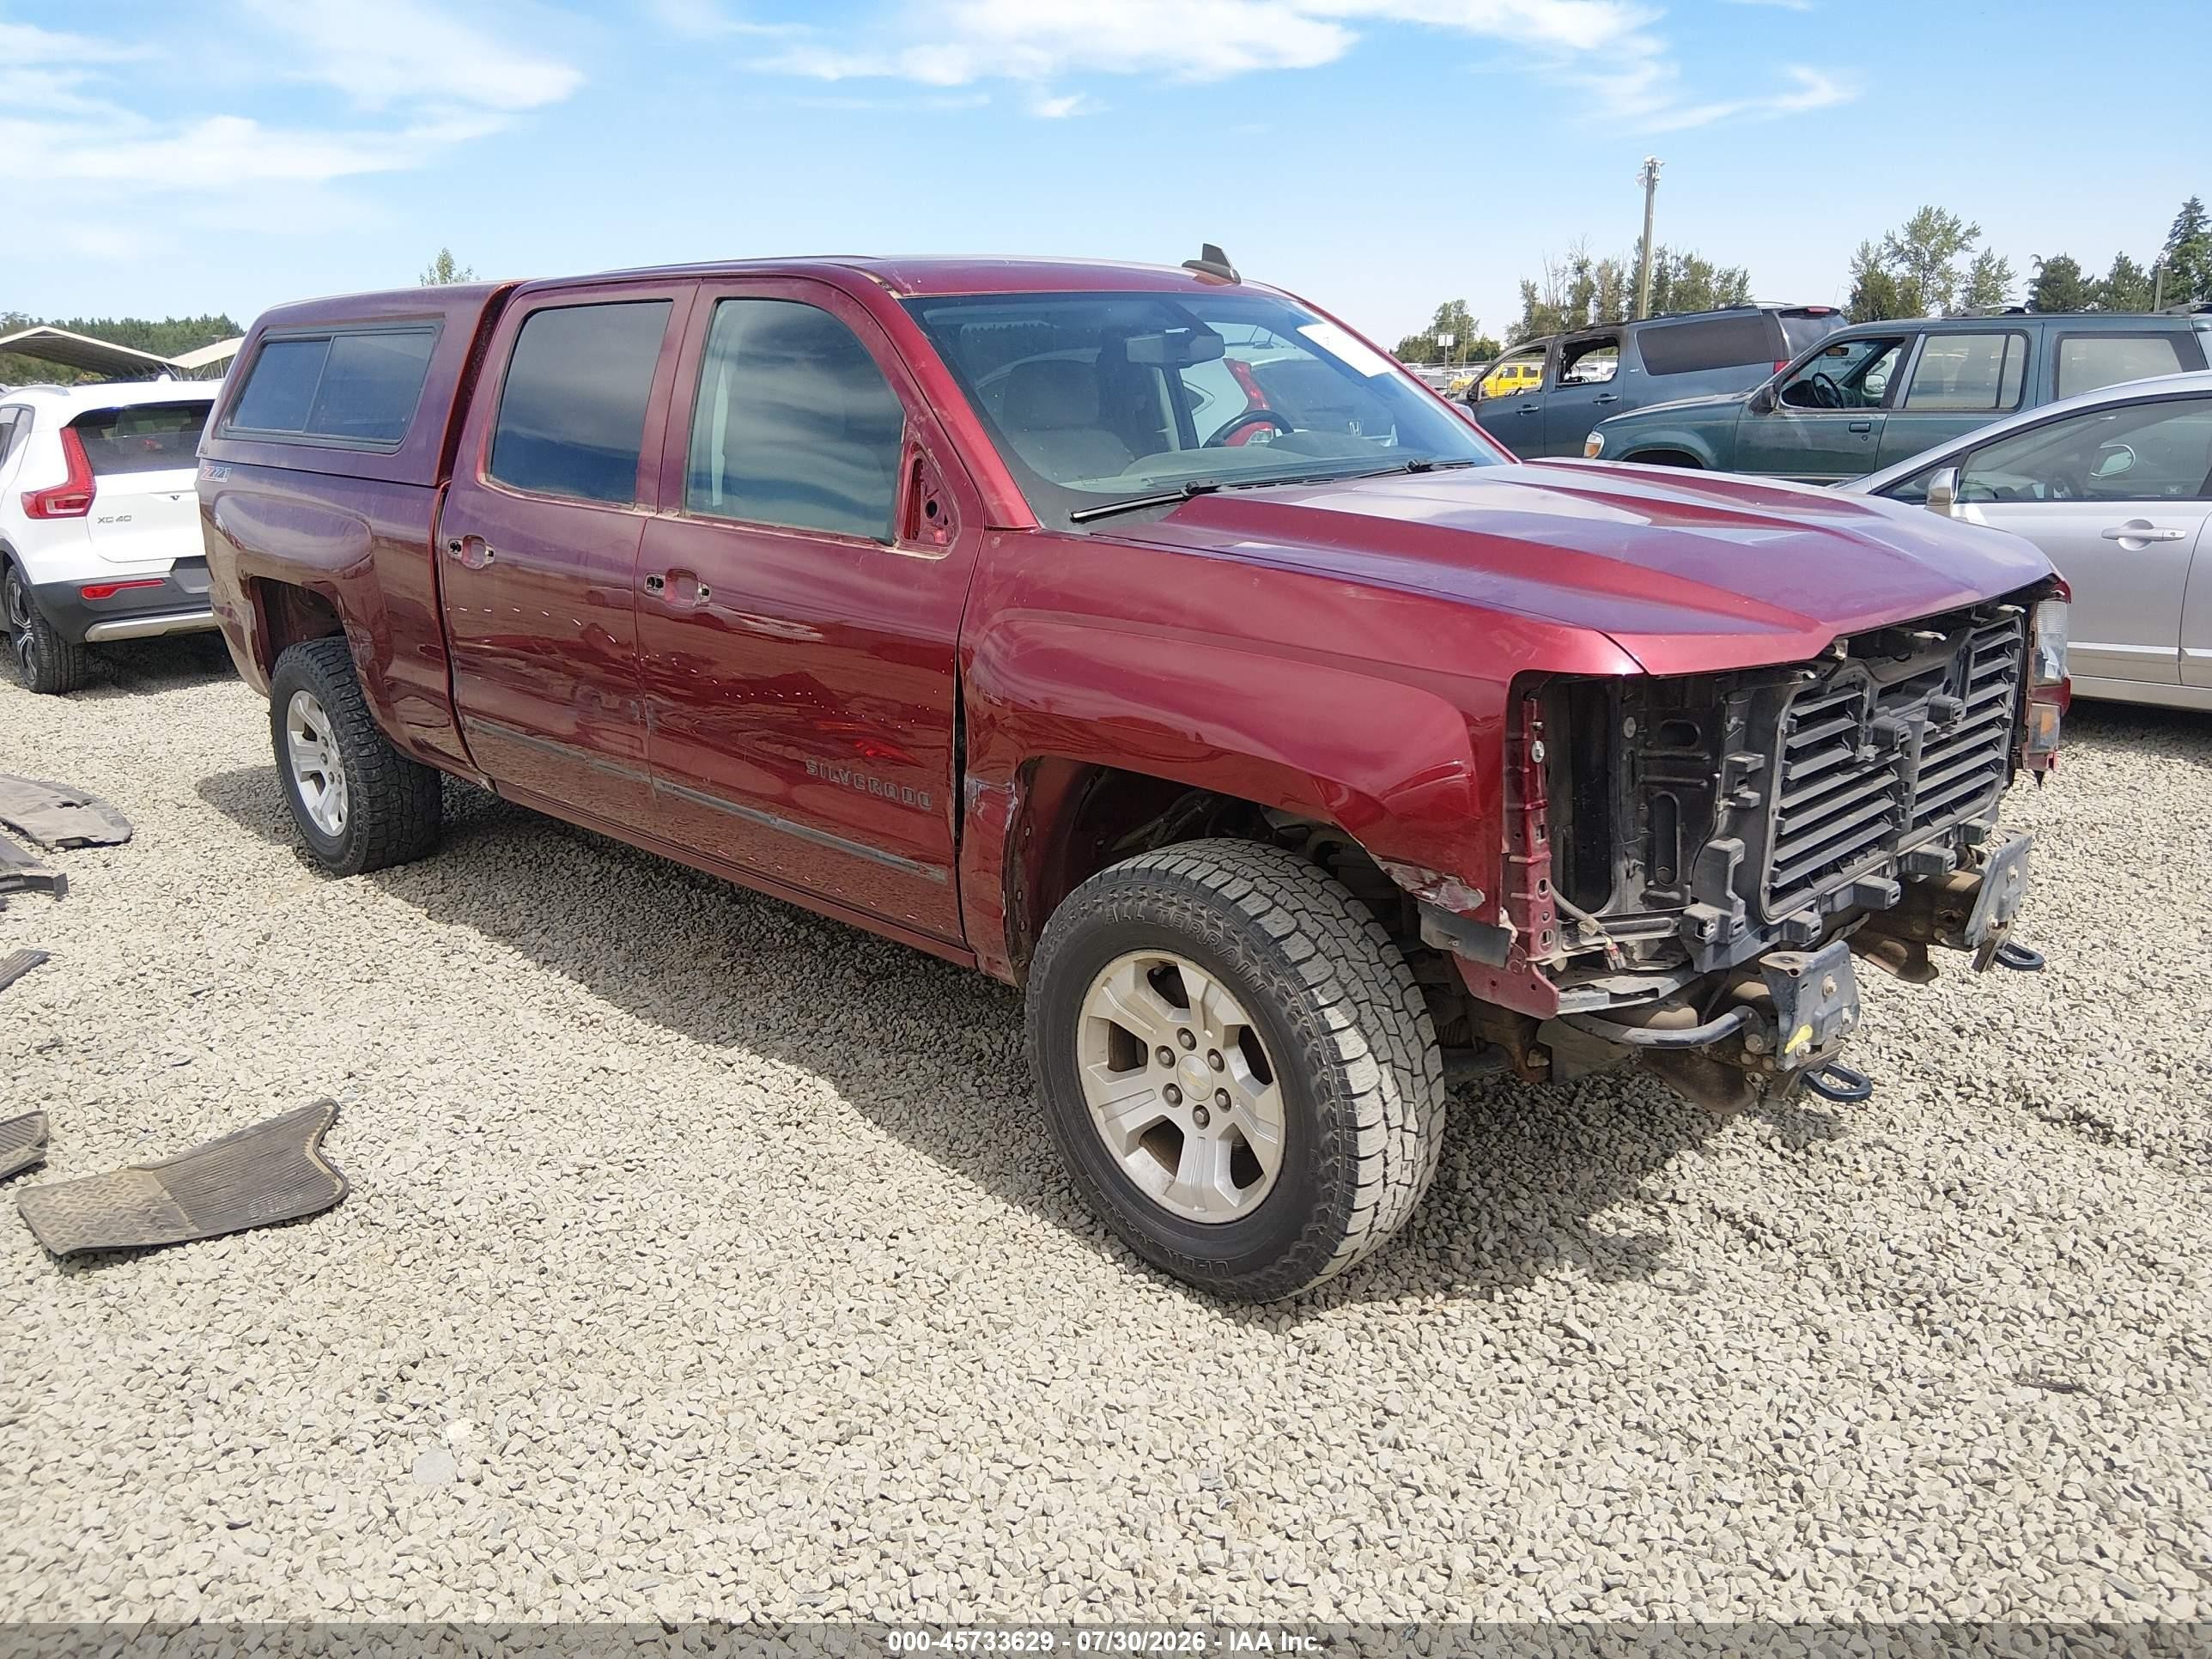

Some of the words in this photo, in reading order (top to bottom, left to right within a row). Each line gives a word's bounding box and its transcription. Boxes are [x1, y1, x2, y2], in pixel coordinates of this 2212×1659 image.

[200, 465, 232, 483] Z71
[805, 759, 933, 811] SILVERADO
[1104, 902, 1146, 927] ALL
[1155, 904, 1268, 994] TERRAIN
